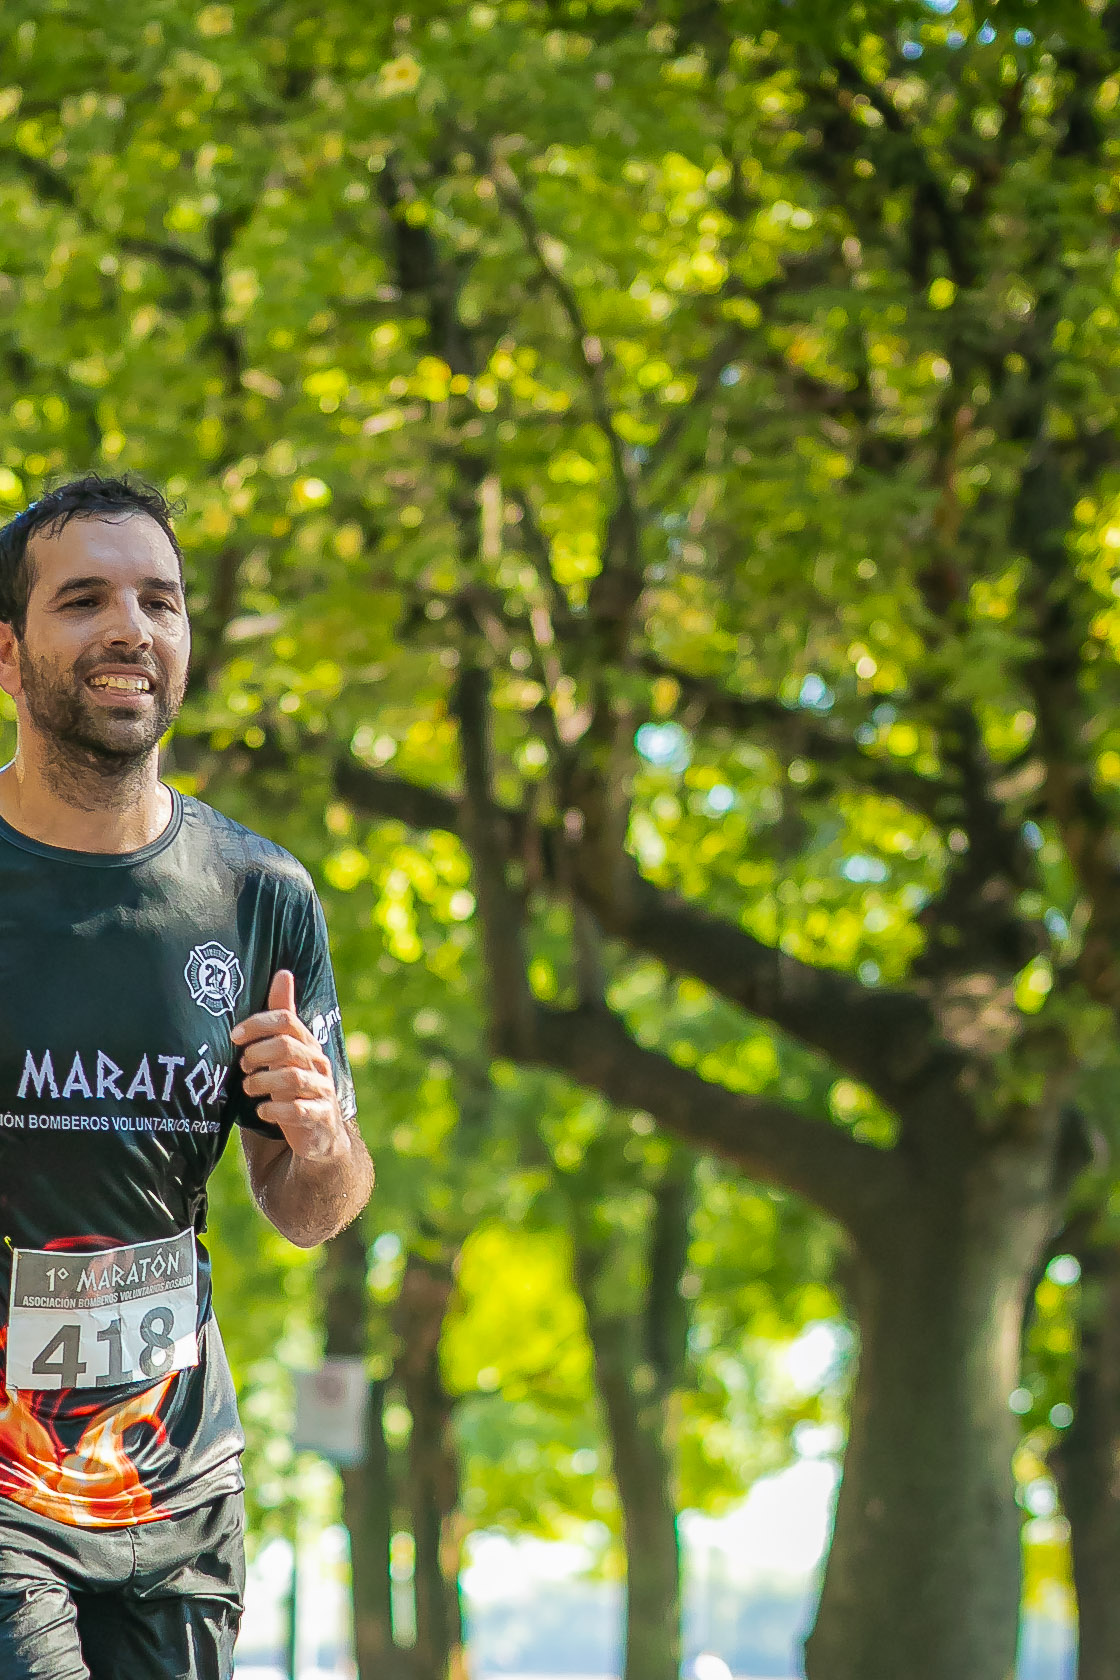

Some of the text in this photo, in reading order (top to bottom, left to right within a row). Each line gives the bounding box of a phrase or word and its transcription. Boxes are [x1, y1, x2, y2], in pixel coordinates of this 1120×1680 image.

[28, 1114, 109, 1132] BOMBEROS
[110, 1115, 190, 1134] VOLUNTARIOS
[76, 1248, 180, 1293] MARATÓN
[22, 1273, 194, 1310] ASOCIACIÓN BOMBEROS VOLUNTARIOS ROSARIO
[31, 1305, 177, 1389] 418
